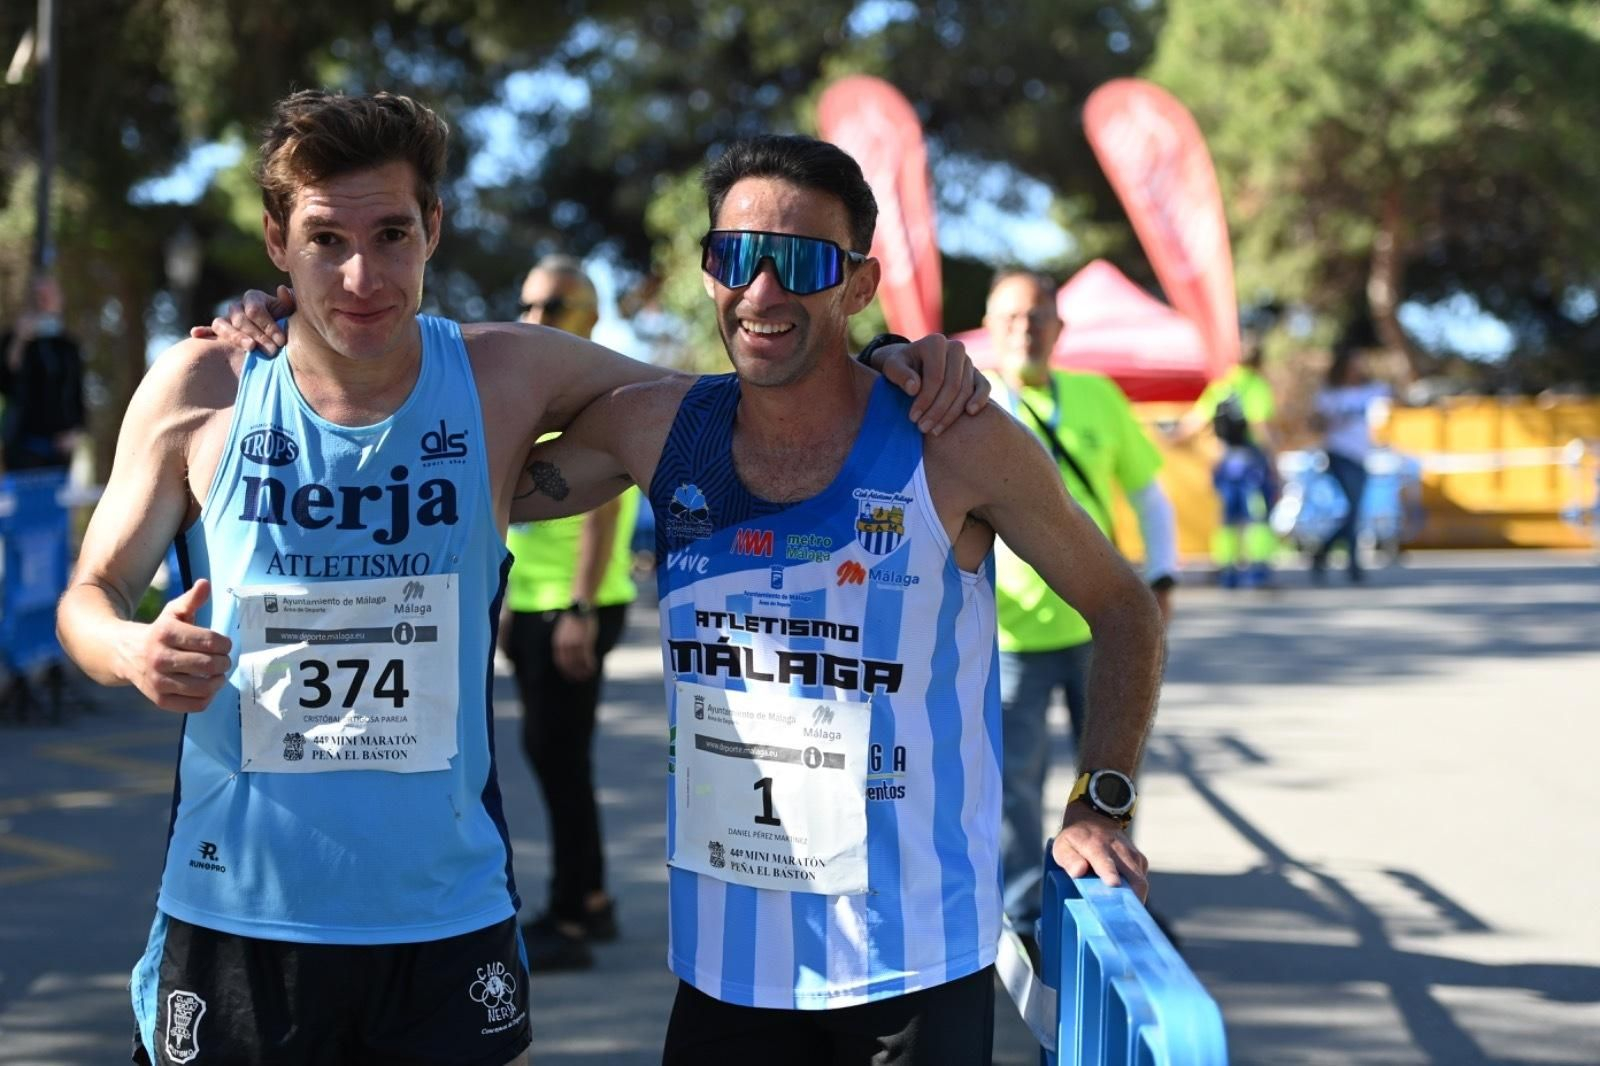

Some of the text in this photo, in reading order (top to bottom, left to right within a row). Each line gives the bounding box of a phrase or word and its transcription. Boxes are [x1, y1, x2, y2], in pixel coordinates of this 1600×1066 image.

[244, 431, 297, 460] TROPS
[238, 465, 459, 545] nerja
[787, 534, 832, 548] metro
[786, 546, 831, 563] Málaga
[266, 552, 430, 577] ATLETISMO
[868, 571, 919, 587] Málaga
[282, 595, 387, 607] Ayuntamiento de Málaga
[394, 603, 432, 616] Málaga
[695, 611, 859, 643] ATLETISMO
[280, 631, 365, 642] www.deporte.malaga.eu
[668, 637, 904, 693] MÁLAGA
[300, 659, 409, 708] 374
[381, 715, 408, 723] PAREJA
[331, 735, 357, 746] MINI
[360, 732, 417, 746] MARATÓN
[803, 727, 842, 741] Málaga
[345, 750, 360, 760] EL
[753, 777, 781, 826] 1
[728, 828, 751, 838] DANIEL
[753, 830, 773, 840] PÉREZ
[743, 850, 769, 862] MINI
[771, 852, 825, 868] MARATÓN
[730, 861, 754, 875] PEÑA
[757, 866, 771, 876] EL
